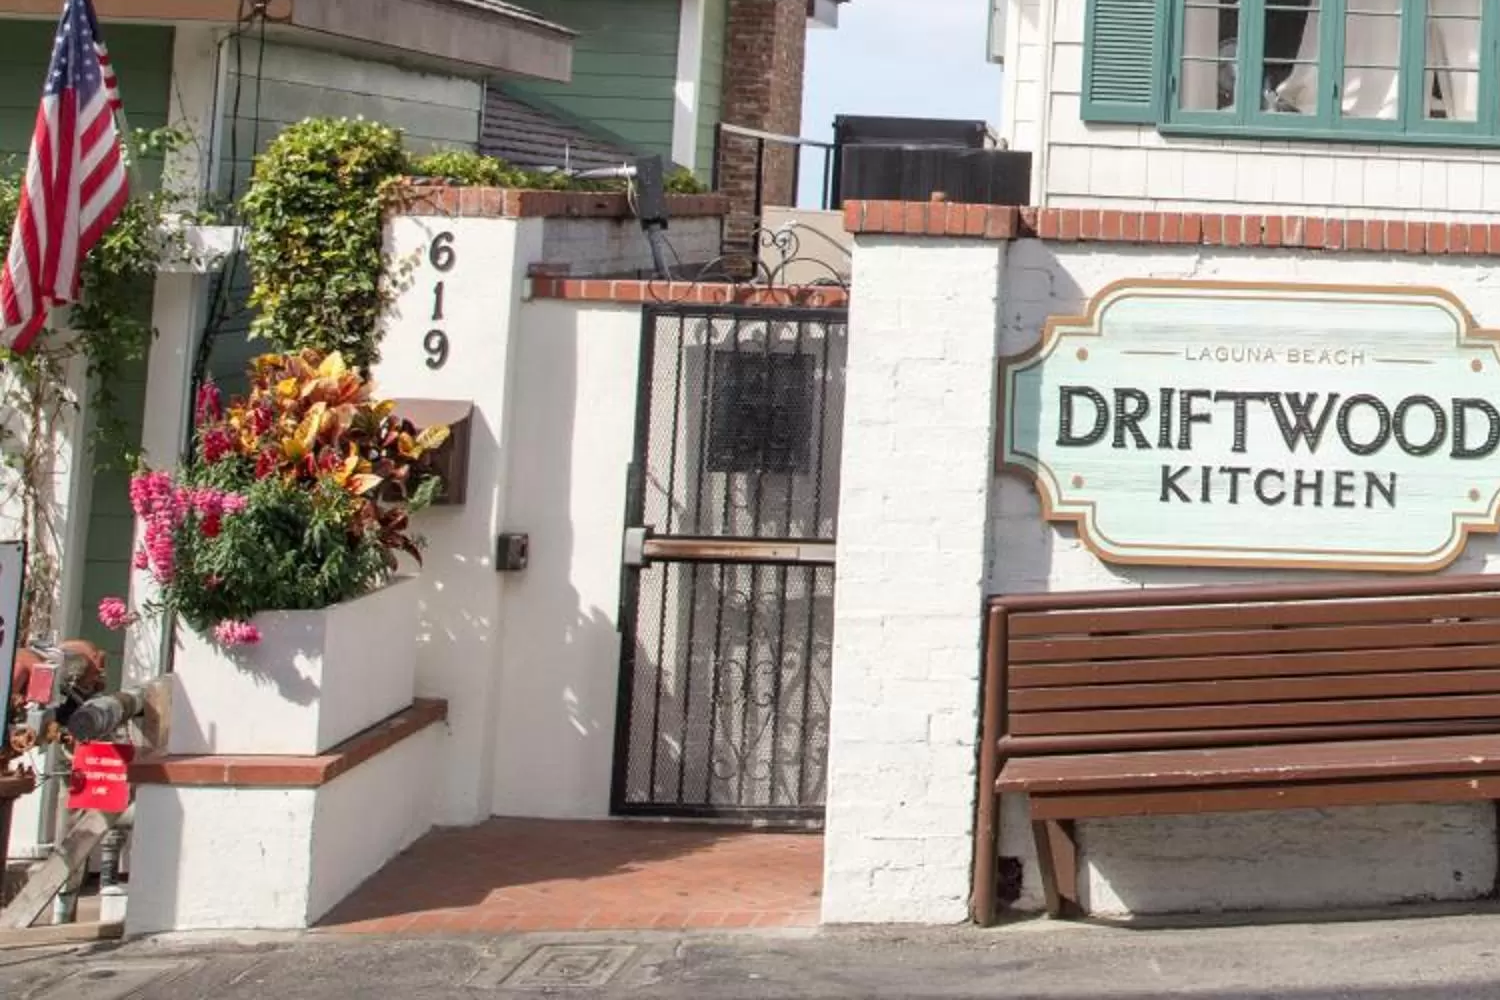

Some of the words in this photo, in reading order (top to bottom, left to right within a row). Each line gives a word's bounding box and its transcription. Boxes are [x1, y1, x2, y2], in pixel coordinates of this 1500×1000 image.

[423, 230, 456, 371] 619
[1184, 345, 1276, 363] LAGUNA
[1286, 348, 1366, 367] BEACH
[1159, 464, 1397, 509] KITCHEN
